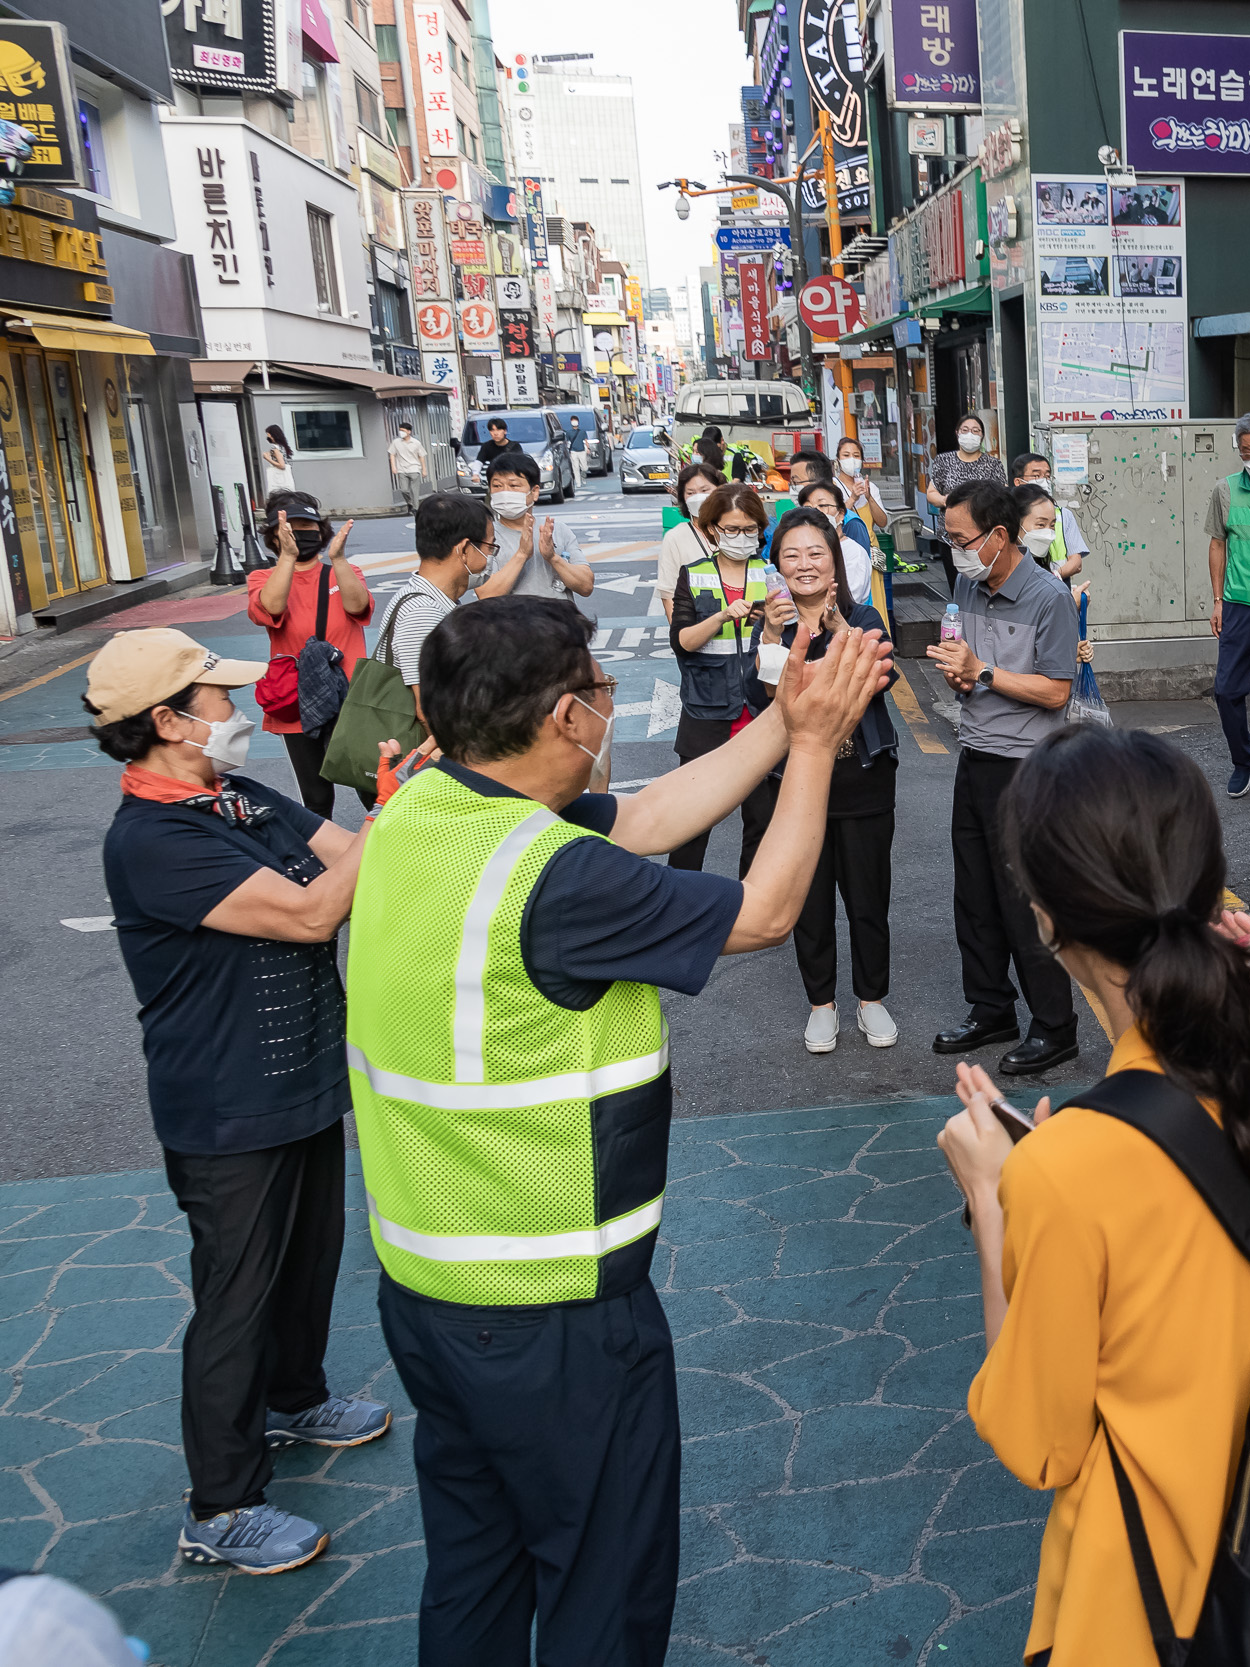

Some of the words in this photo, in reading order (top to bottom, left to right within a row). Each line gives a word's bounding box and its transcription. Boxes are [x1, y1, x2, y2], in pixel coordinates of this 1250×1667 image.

[417, 11, 454, 150] 경성포차
[196, 148, 240, 285] 바른치킨
[449, 219, 483, 239] 태국
[421, 308, 449, 336] 회
[464, 308, 492, 336] 회
[747, 267, 764, 338] 새마을식당
[801, 281, 852, 334] 약
[1039, 302, 1059, 311] KBS
